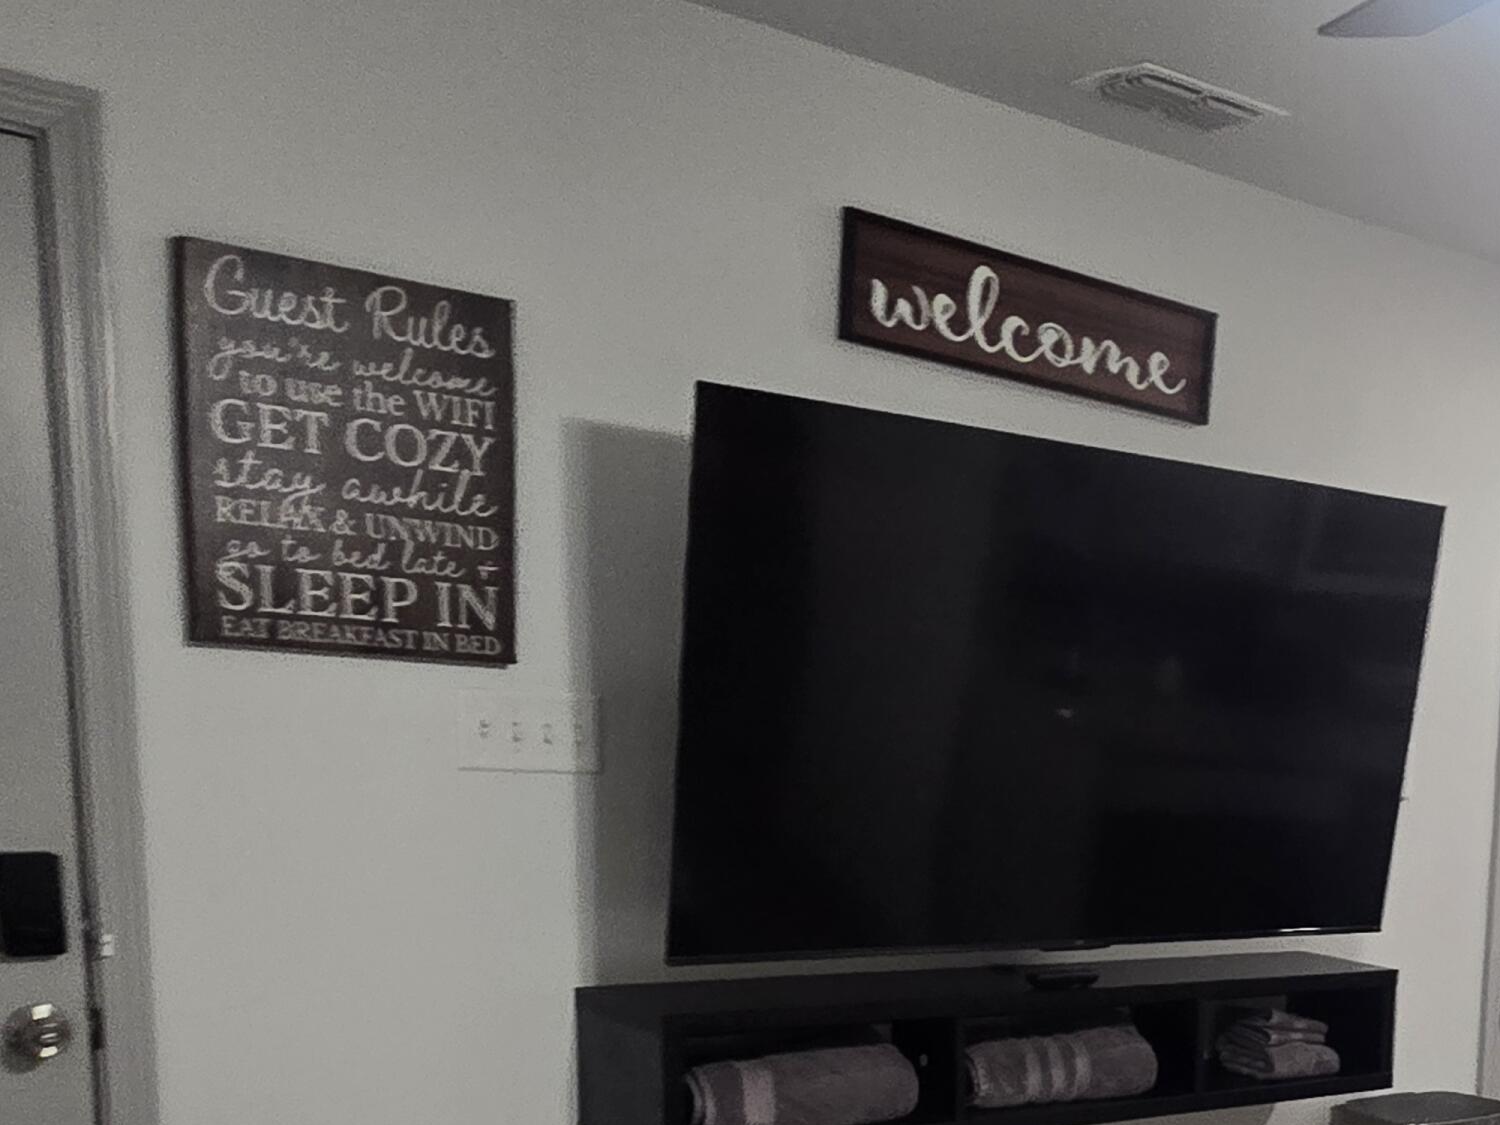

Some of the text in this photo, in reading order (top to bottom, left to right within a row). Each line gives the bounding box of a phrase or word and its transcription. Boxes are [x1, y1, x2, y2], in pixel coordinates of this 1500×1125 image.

[204, 254, 496, 359] Guest Rules
[870, 265, 1187, 395] welcome
[352, 348, 498, 397] welcome
[352, 381, 406, 417] the
[413, 390, 496, 431] WIFI
[209, 398, 497, 477] GET COZY
[213, 449, 498, 518] stay awhile
[332, 539, 391, 571] bed
[402, 538, 467, 579] late
[365, 513, 499, 550] UNWIND
[215, 560, 500, 632] SLEEP IN
[219, 614, 501, 656] EAT BREAKFAST IN BED
